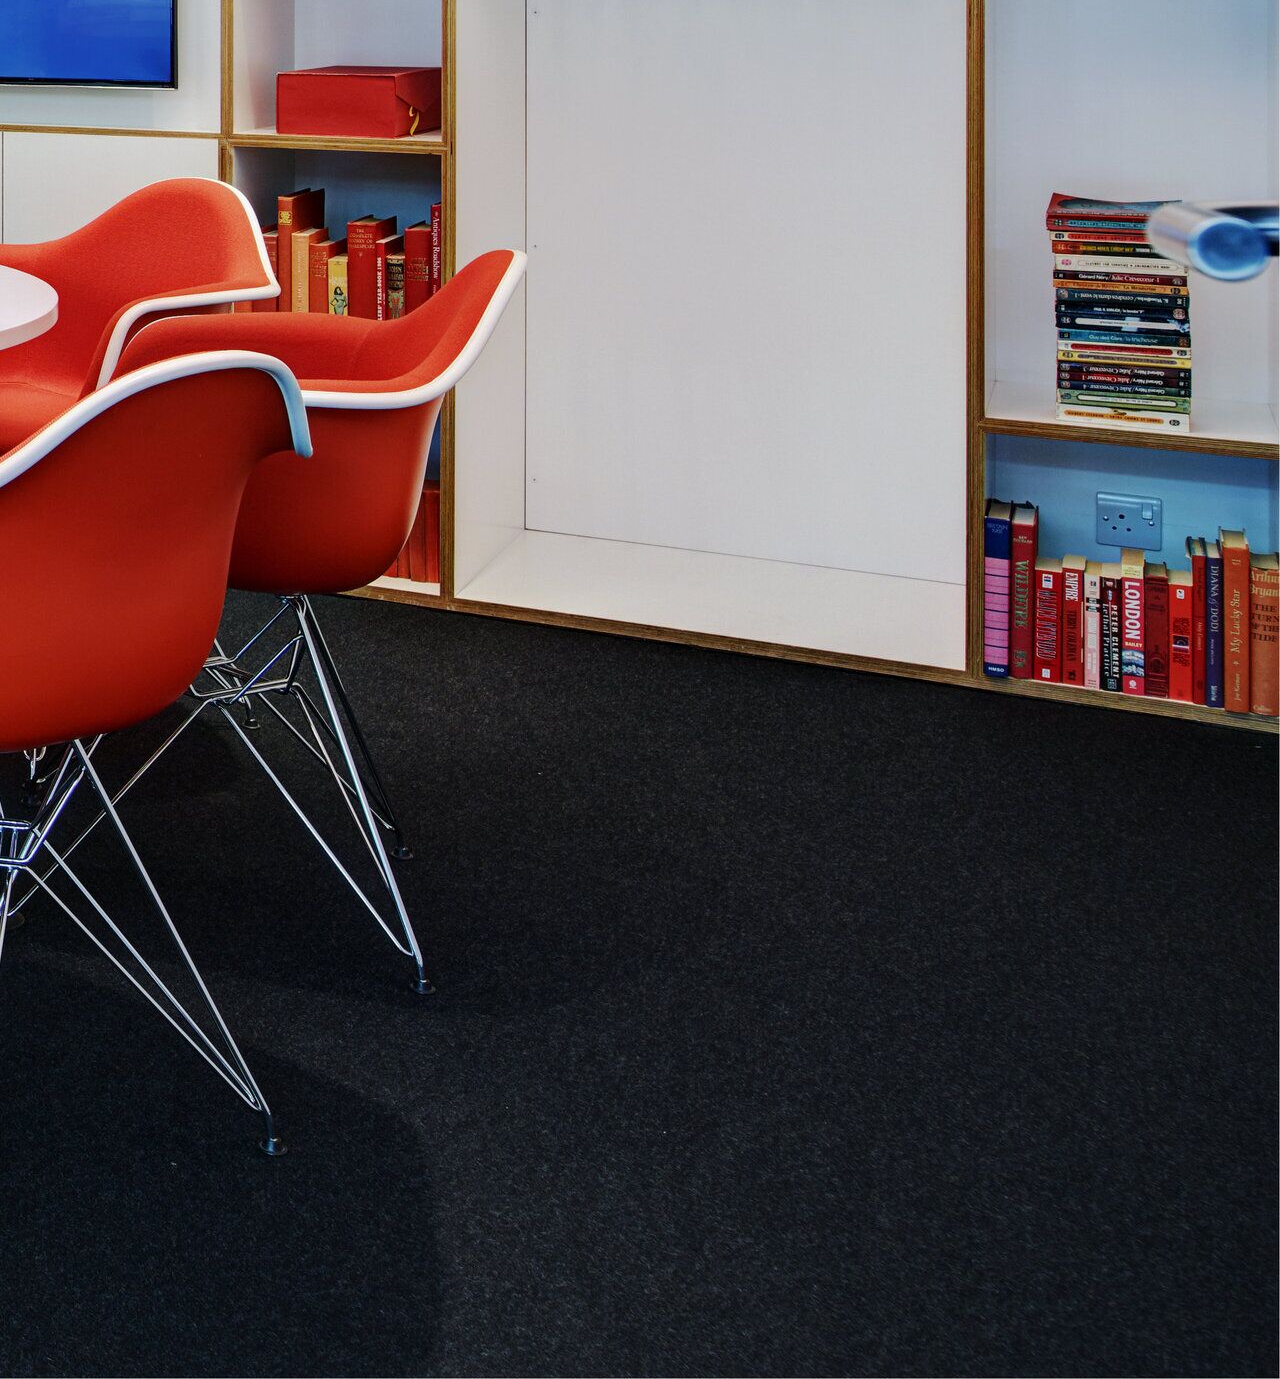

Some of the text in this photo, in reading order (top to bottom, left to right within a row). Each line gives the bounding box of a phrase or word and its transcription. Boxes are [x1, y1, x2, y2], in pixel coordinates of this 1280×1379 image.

[432, 217, 440, 246] Antiques
[432, 246, 440, 279] Roadshow
[1014, 560, 1029, 628] WILDFIRE
[1065, 571, 1079, 602] EMPIRE
[1210, 565, 1220, 597] DIANA
[1124, 581, 1141, 640] LONDON
[1211, 606, 1220, 632] DODI
[1230, 589, 1242, 653] My Lucky Star
[1255, 604, 1277, 613] THE
[1111, 604, 1120, 678] PETER CLEMENT
[1253, 633, 1277, 643] TIDE
